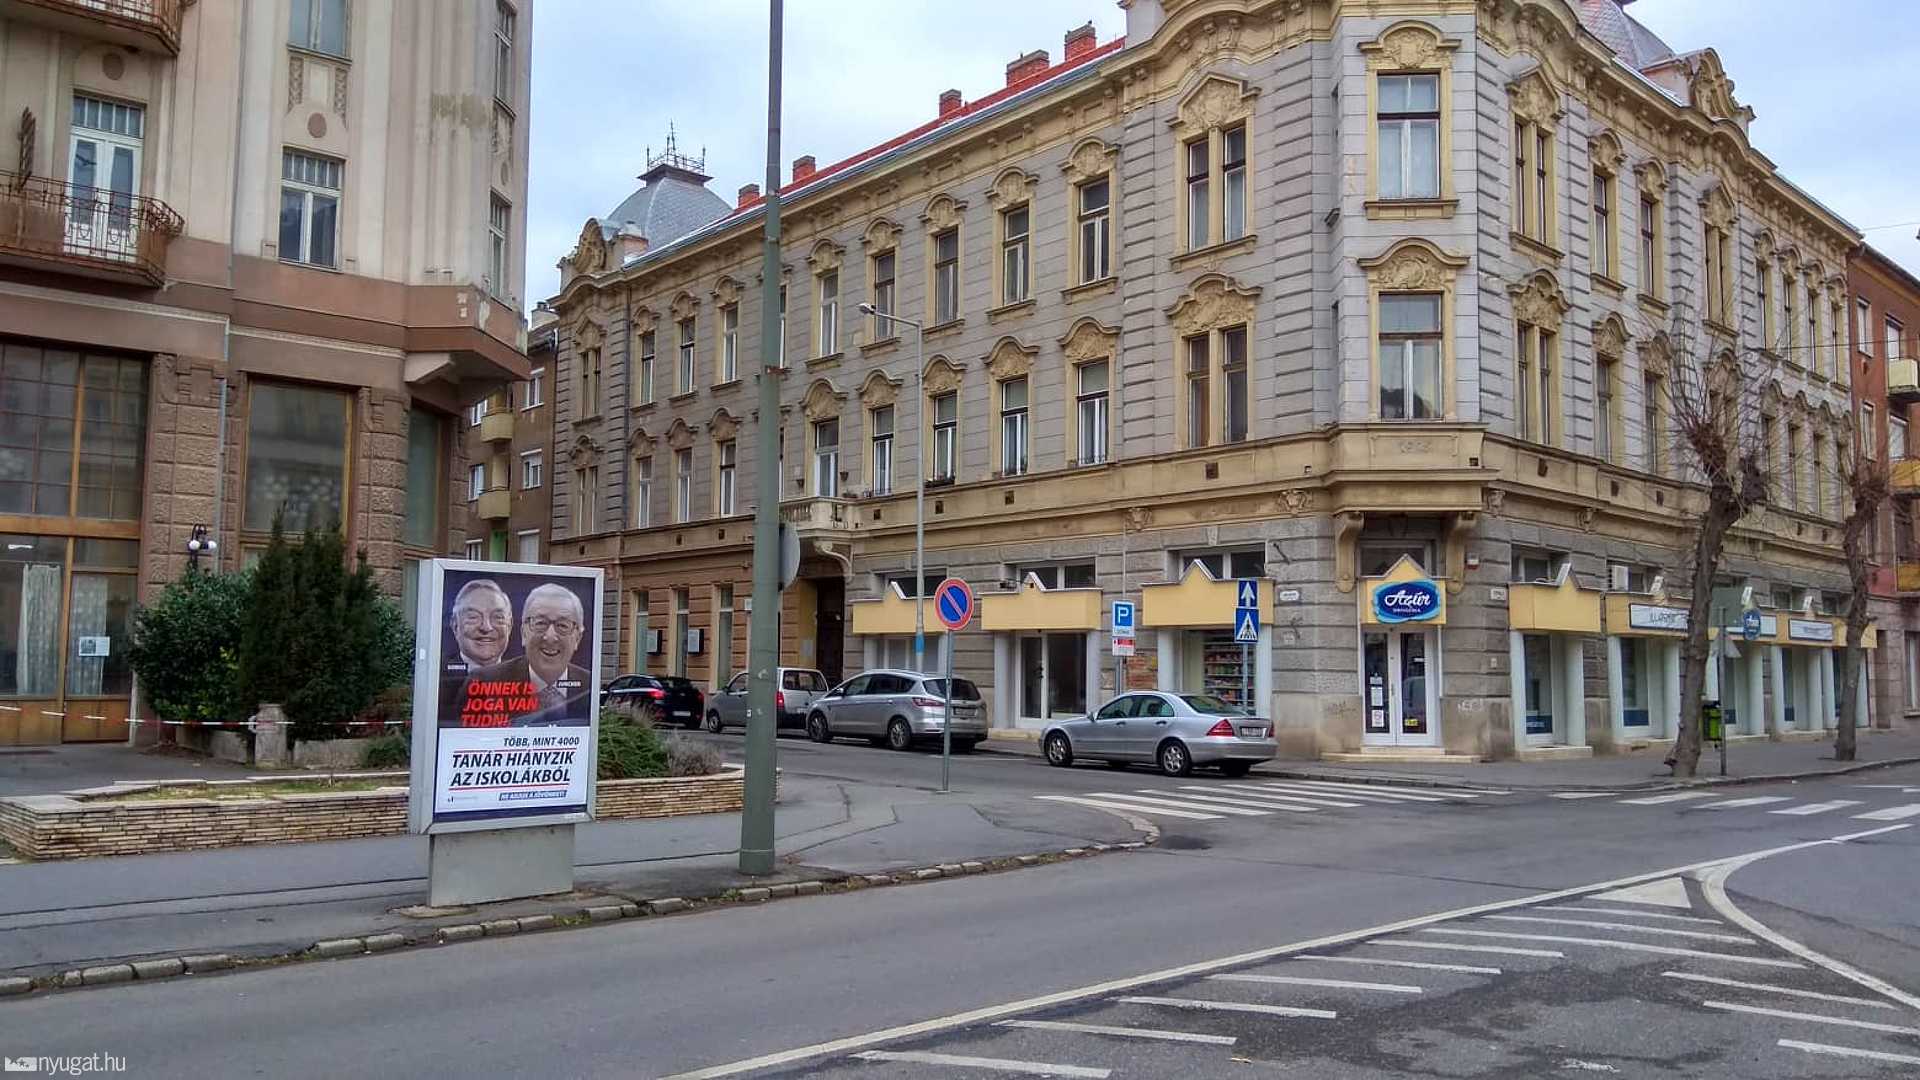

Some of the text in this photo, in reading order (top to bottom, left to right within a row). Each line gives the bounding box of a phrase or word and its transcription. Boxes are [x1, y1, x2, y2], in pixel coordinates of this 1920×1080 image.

[1384, 589, 1430, 608] Azúr
[1117, 606, 1129, 624] P
[468, 679, 536, 696] ÖNNEK IS
[462, 697, 539, 711] JOGA VAN
[504, 736, 580, 747] TÖBB, MINT 4000
[453, 748, 575, 769] TANÁR HIÁNYZIK
[450, 766, 571, 787] AZ ISKOLÁKBÓL
